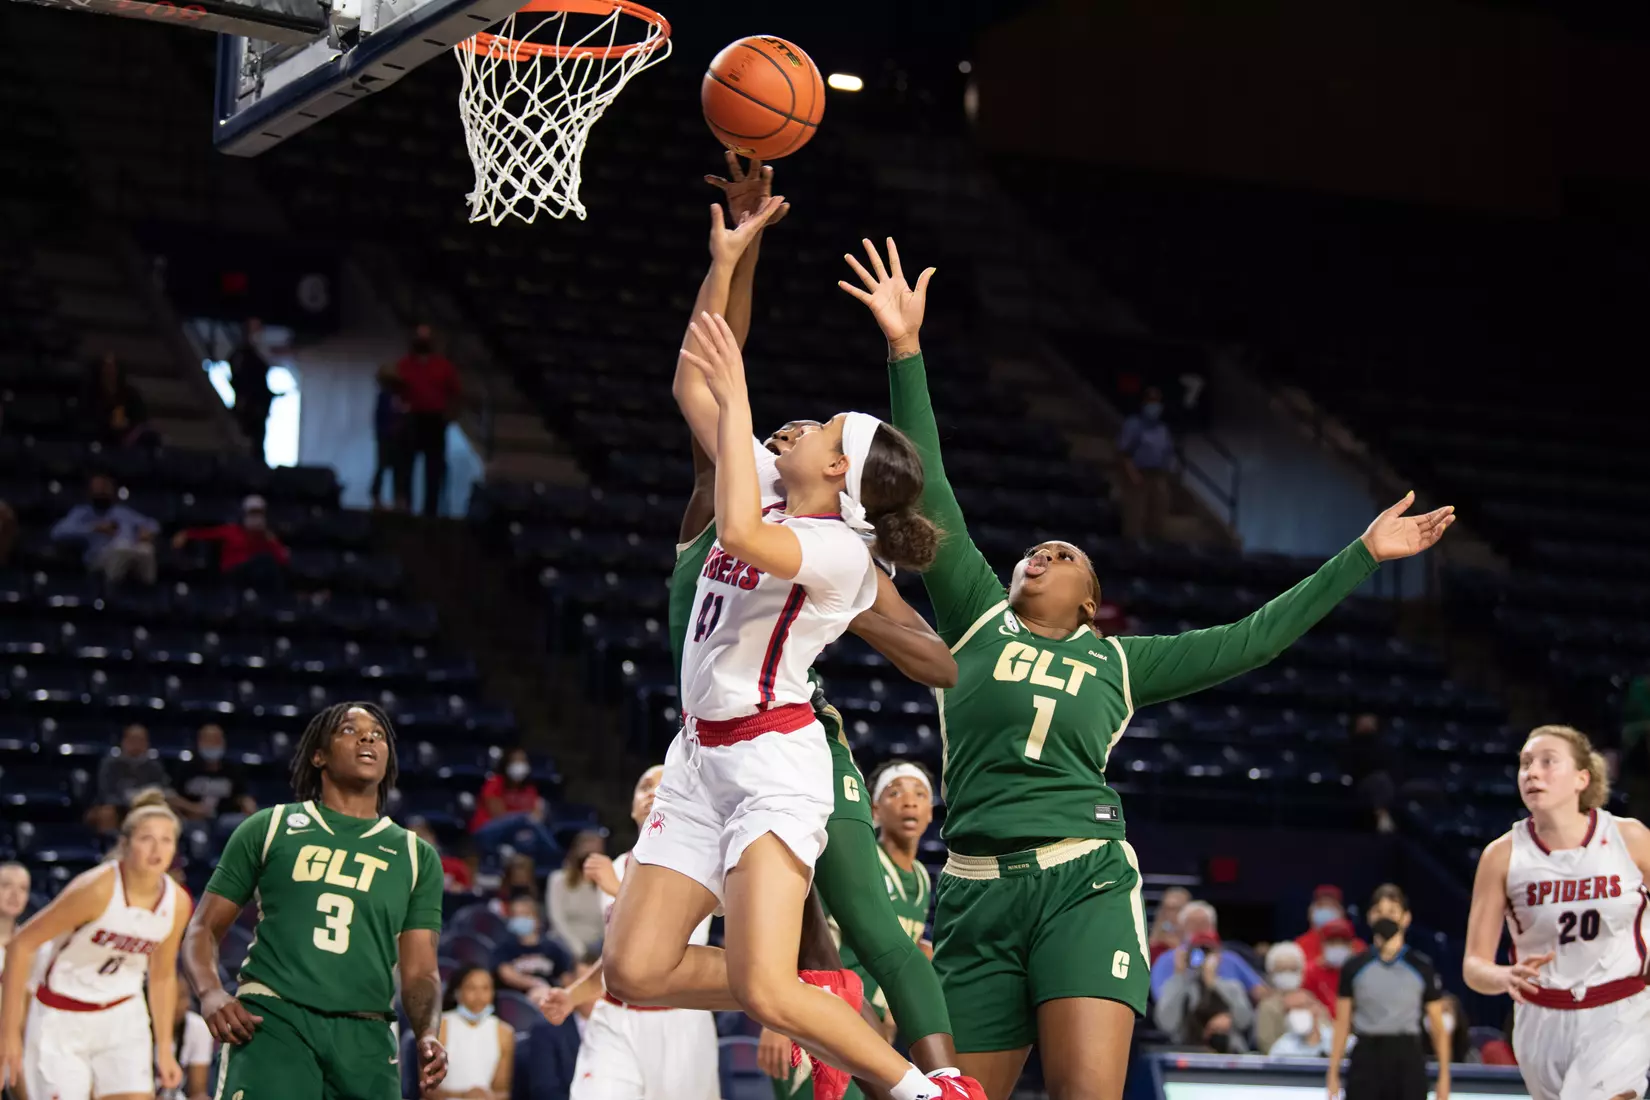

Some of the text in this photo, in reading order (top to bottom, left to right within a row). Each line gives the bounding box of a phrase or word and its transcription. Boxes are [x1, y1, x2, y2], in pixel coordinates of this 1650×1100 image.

[1178, 372, 1205, 410] 7
[693, 592, 724, 643] 41
[992, 641, 1097, 697] CLT
[1024, 694, 1057, 761] 1
[291, 844, 390, 893] CLT
[1526, 874, 1622, 907] SPIDERS
[313, 892, 355, 955] 3
[1558, 908, 1601, 945] 20
